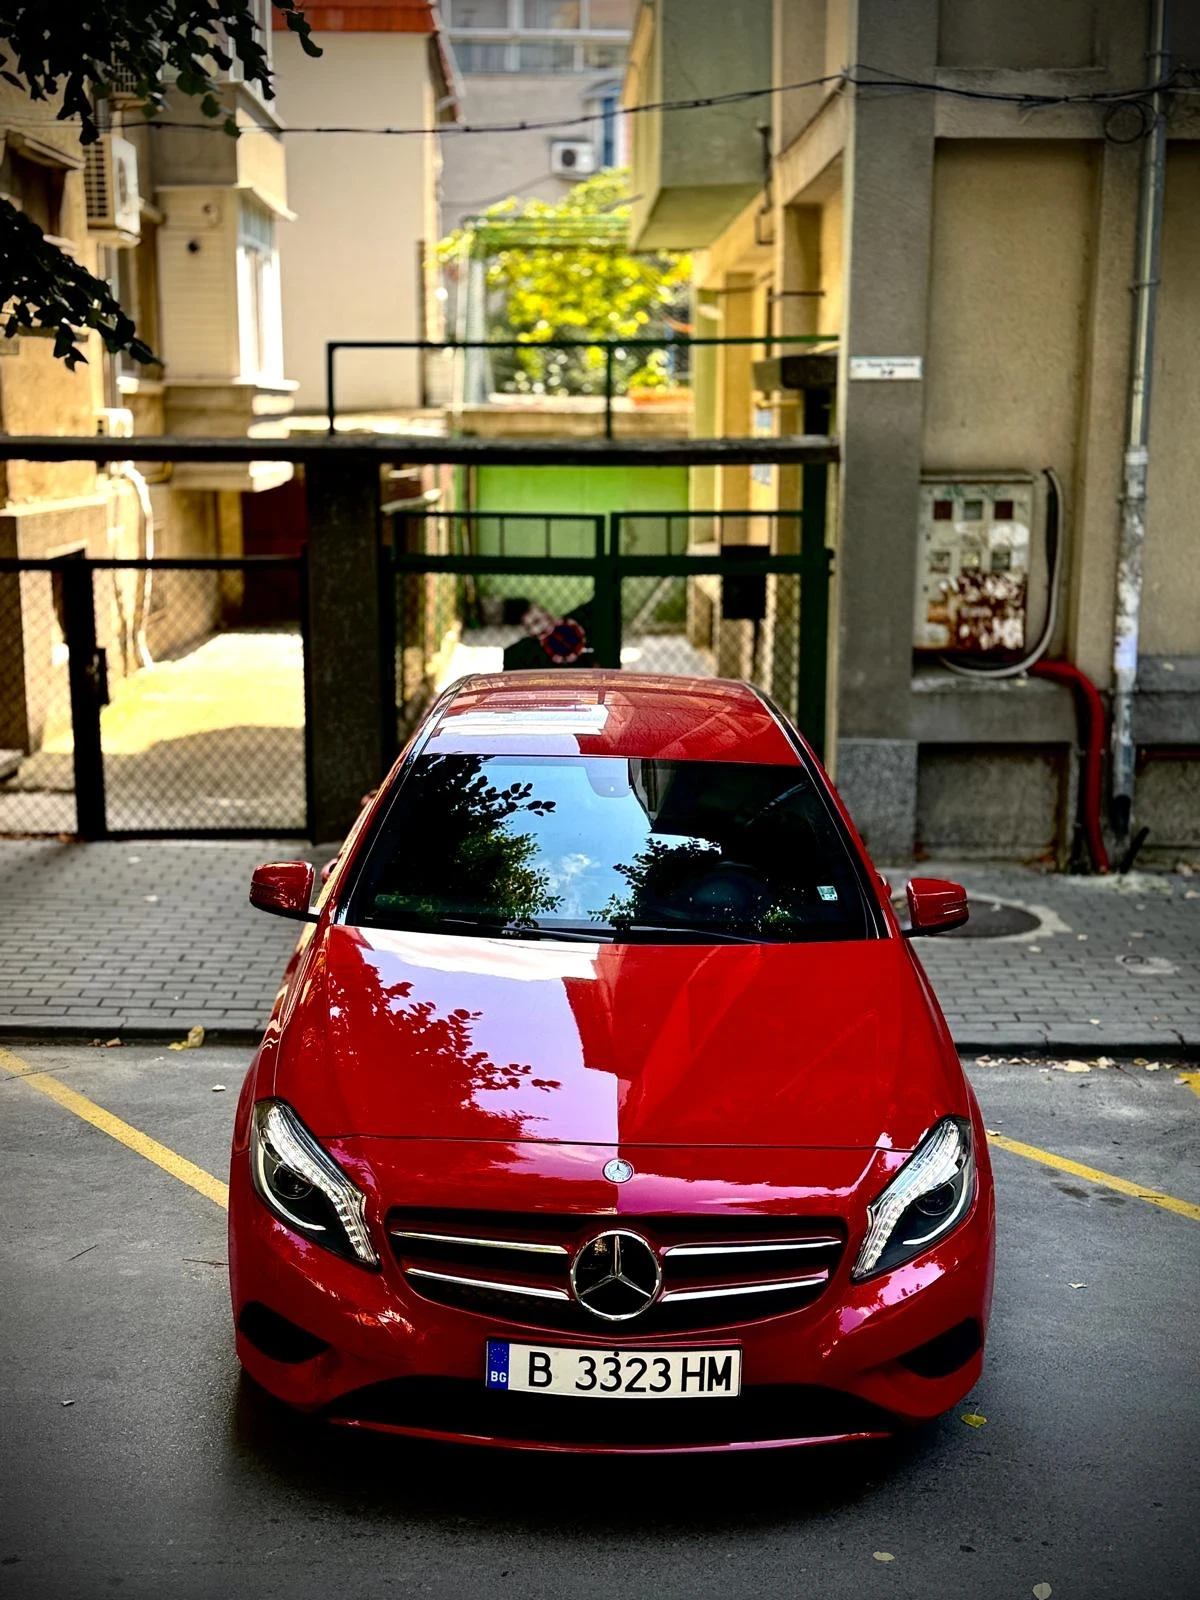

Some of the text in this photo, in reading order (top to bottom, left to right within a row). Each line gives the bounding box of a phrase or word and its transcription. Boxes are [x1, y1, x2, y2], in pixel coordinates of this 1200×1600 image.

[490, 1371, 507, 1382] BG
[528, 1351, 732, 1392] B 3323 HM
